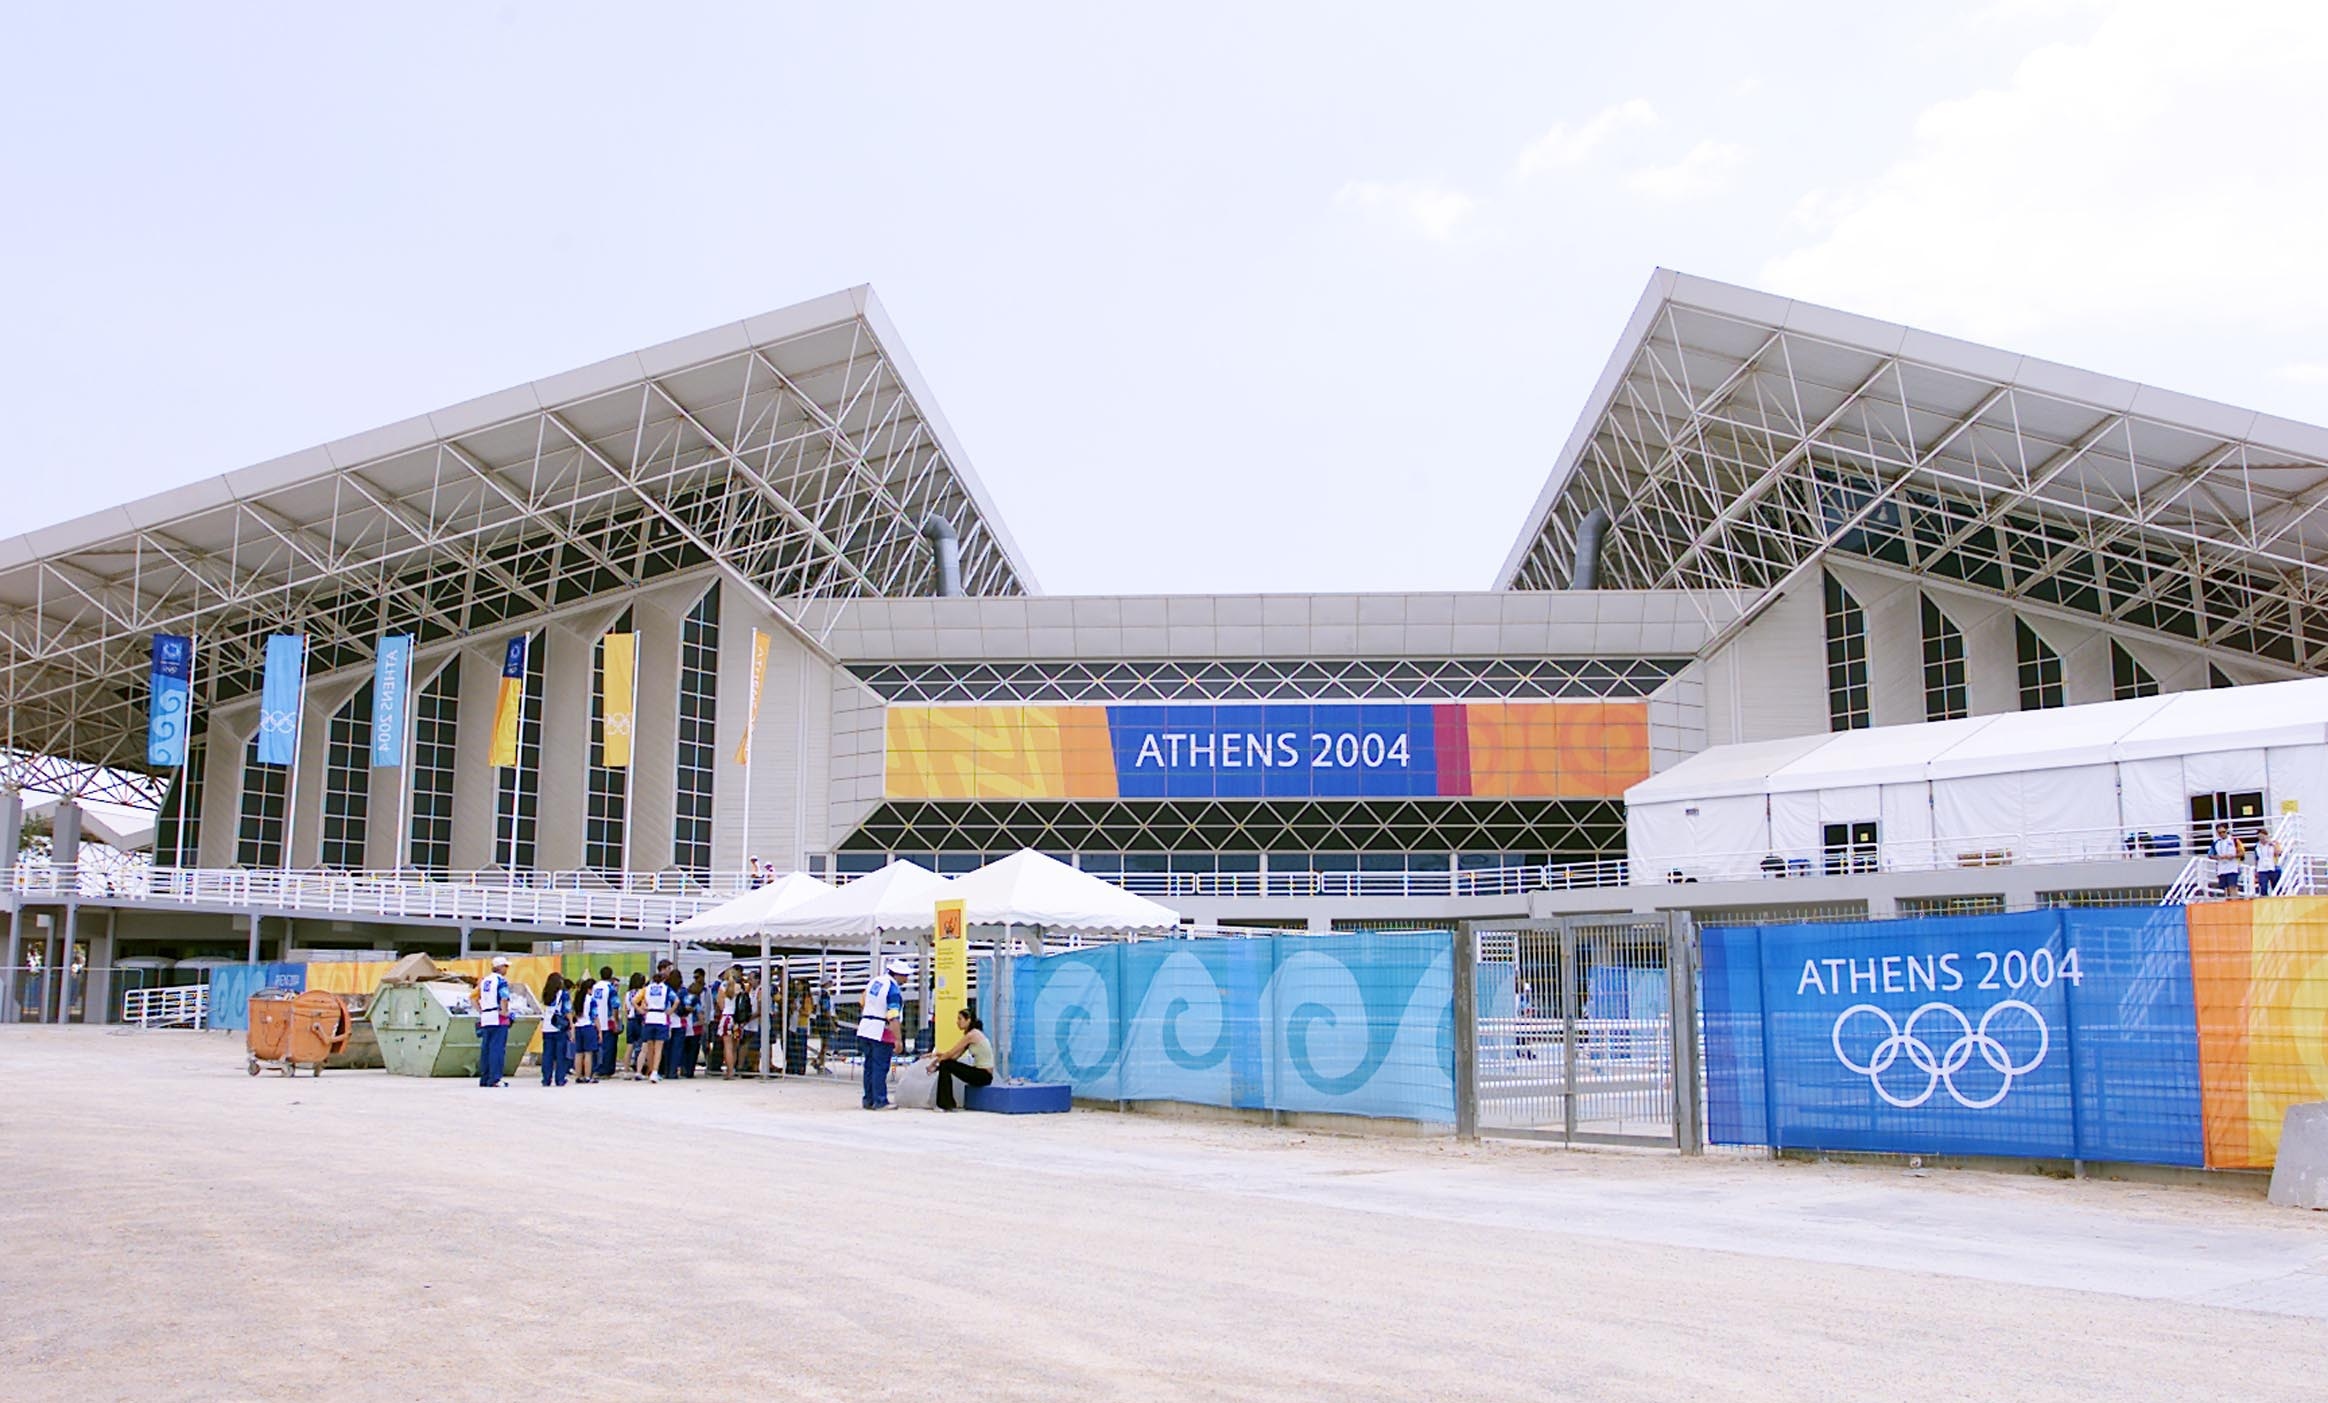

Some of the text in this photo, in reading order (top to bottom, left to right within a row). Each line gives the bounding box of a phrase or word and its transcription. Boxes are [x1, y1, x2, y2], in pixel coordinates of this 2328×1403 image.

[1135, 733, 1410, 767] ATHENS 2004
[1797, 947, 2084, 995] ATHENS 2004
